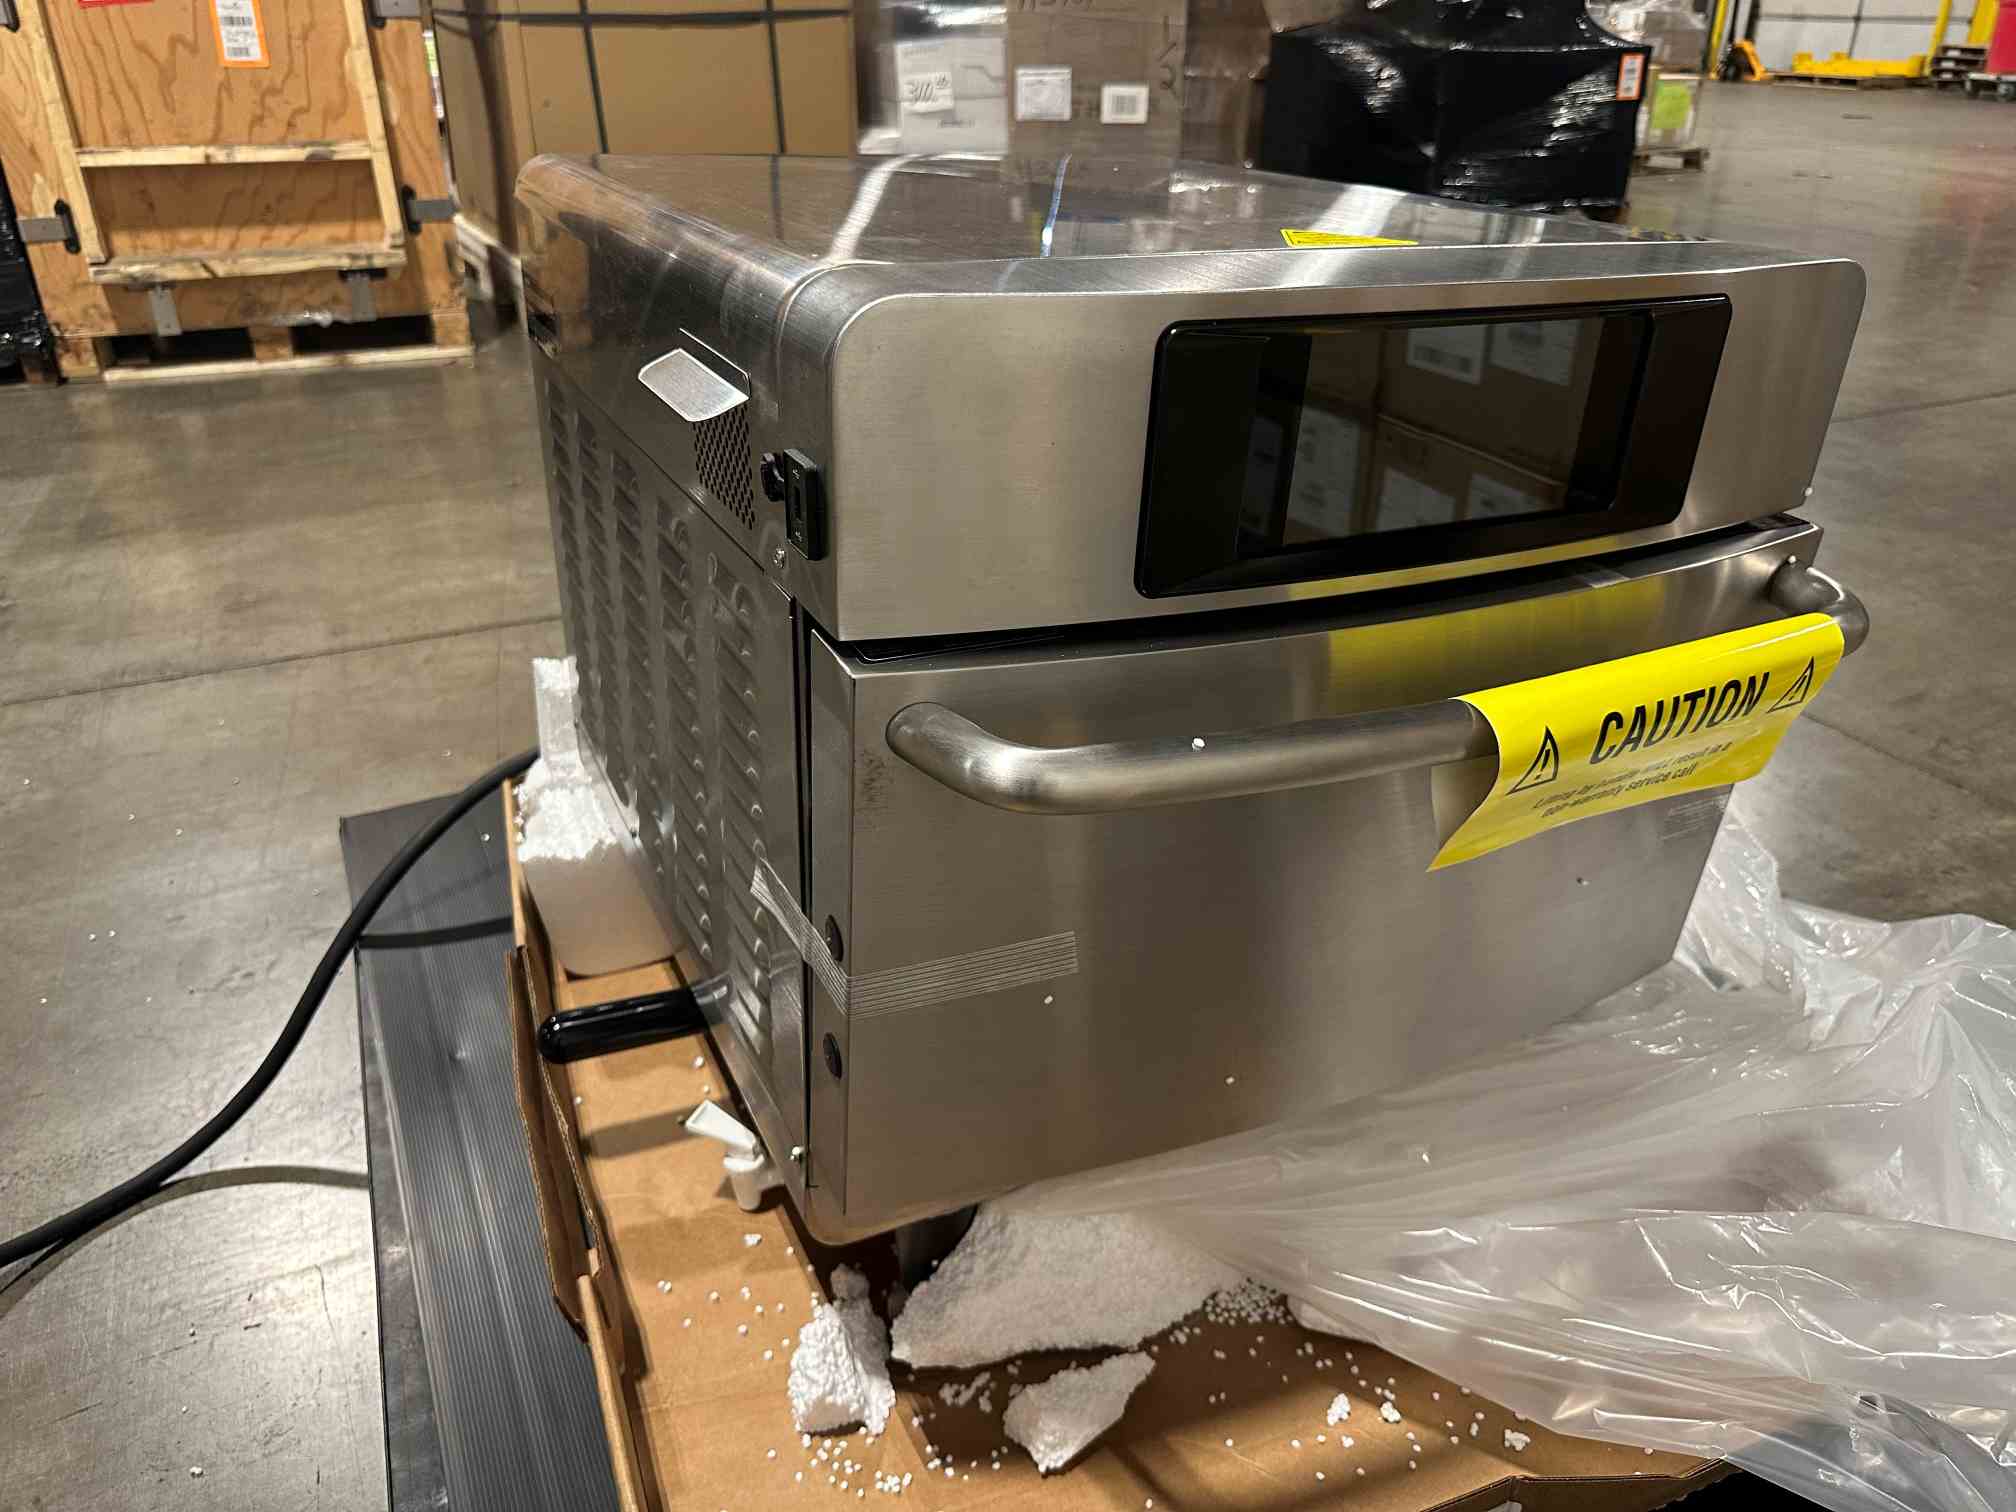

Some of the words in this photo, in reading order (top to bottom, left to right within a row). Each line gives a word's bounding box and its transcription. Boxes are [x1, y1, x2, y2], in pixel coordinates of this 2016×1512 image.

[1589, 671, 1770, 764] CAUTION
[1624, 771, 1672, 791] service
[1671, 760, 1698, 780] call
